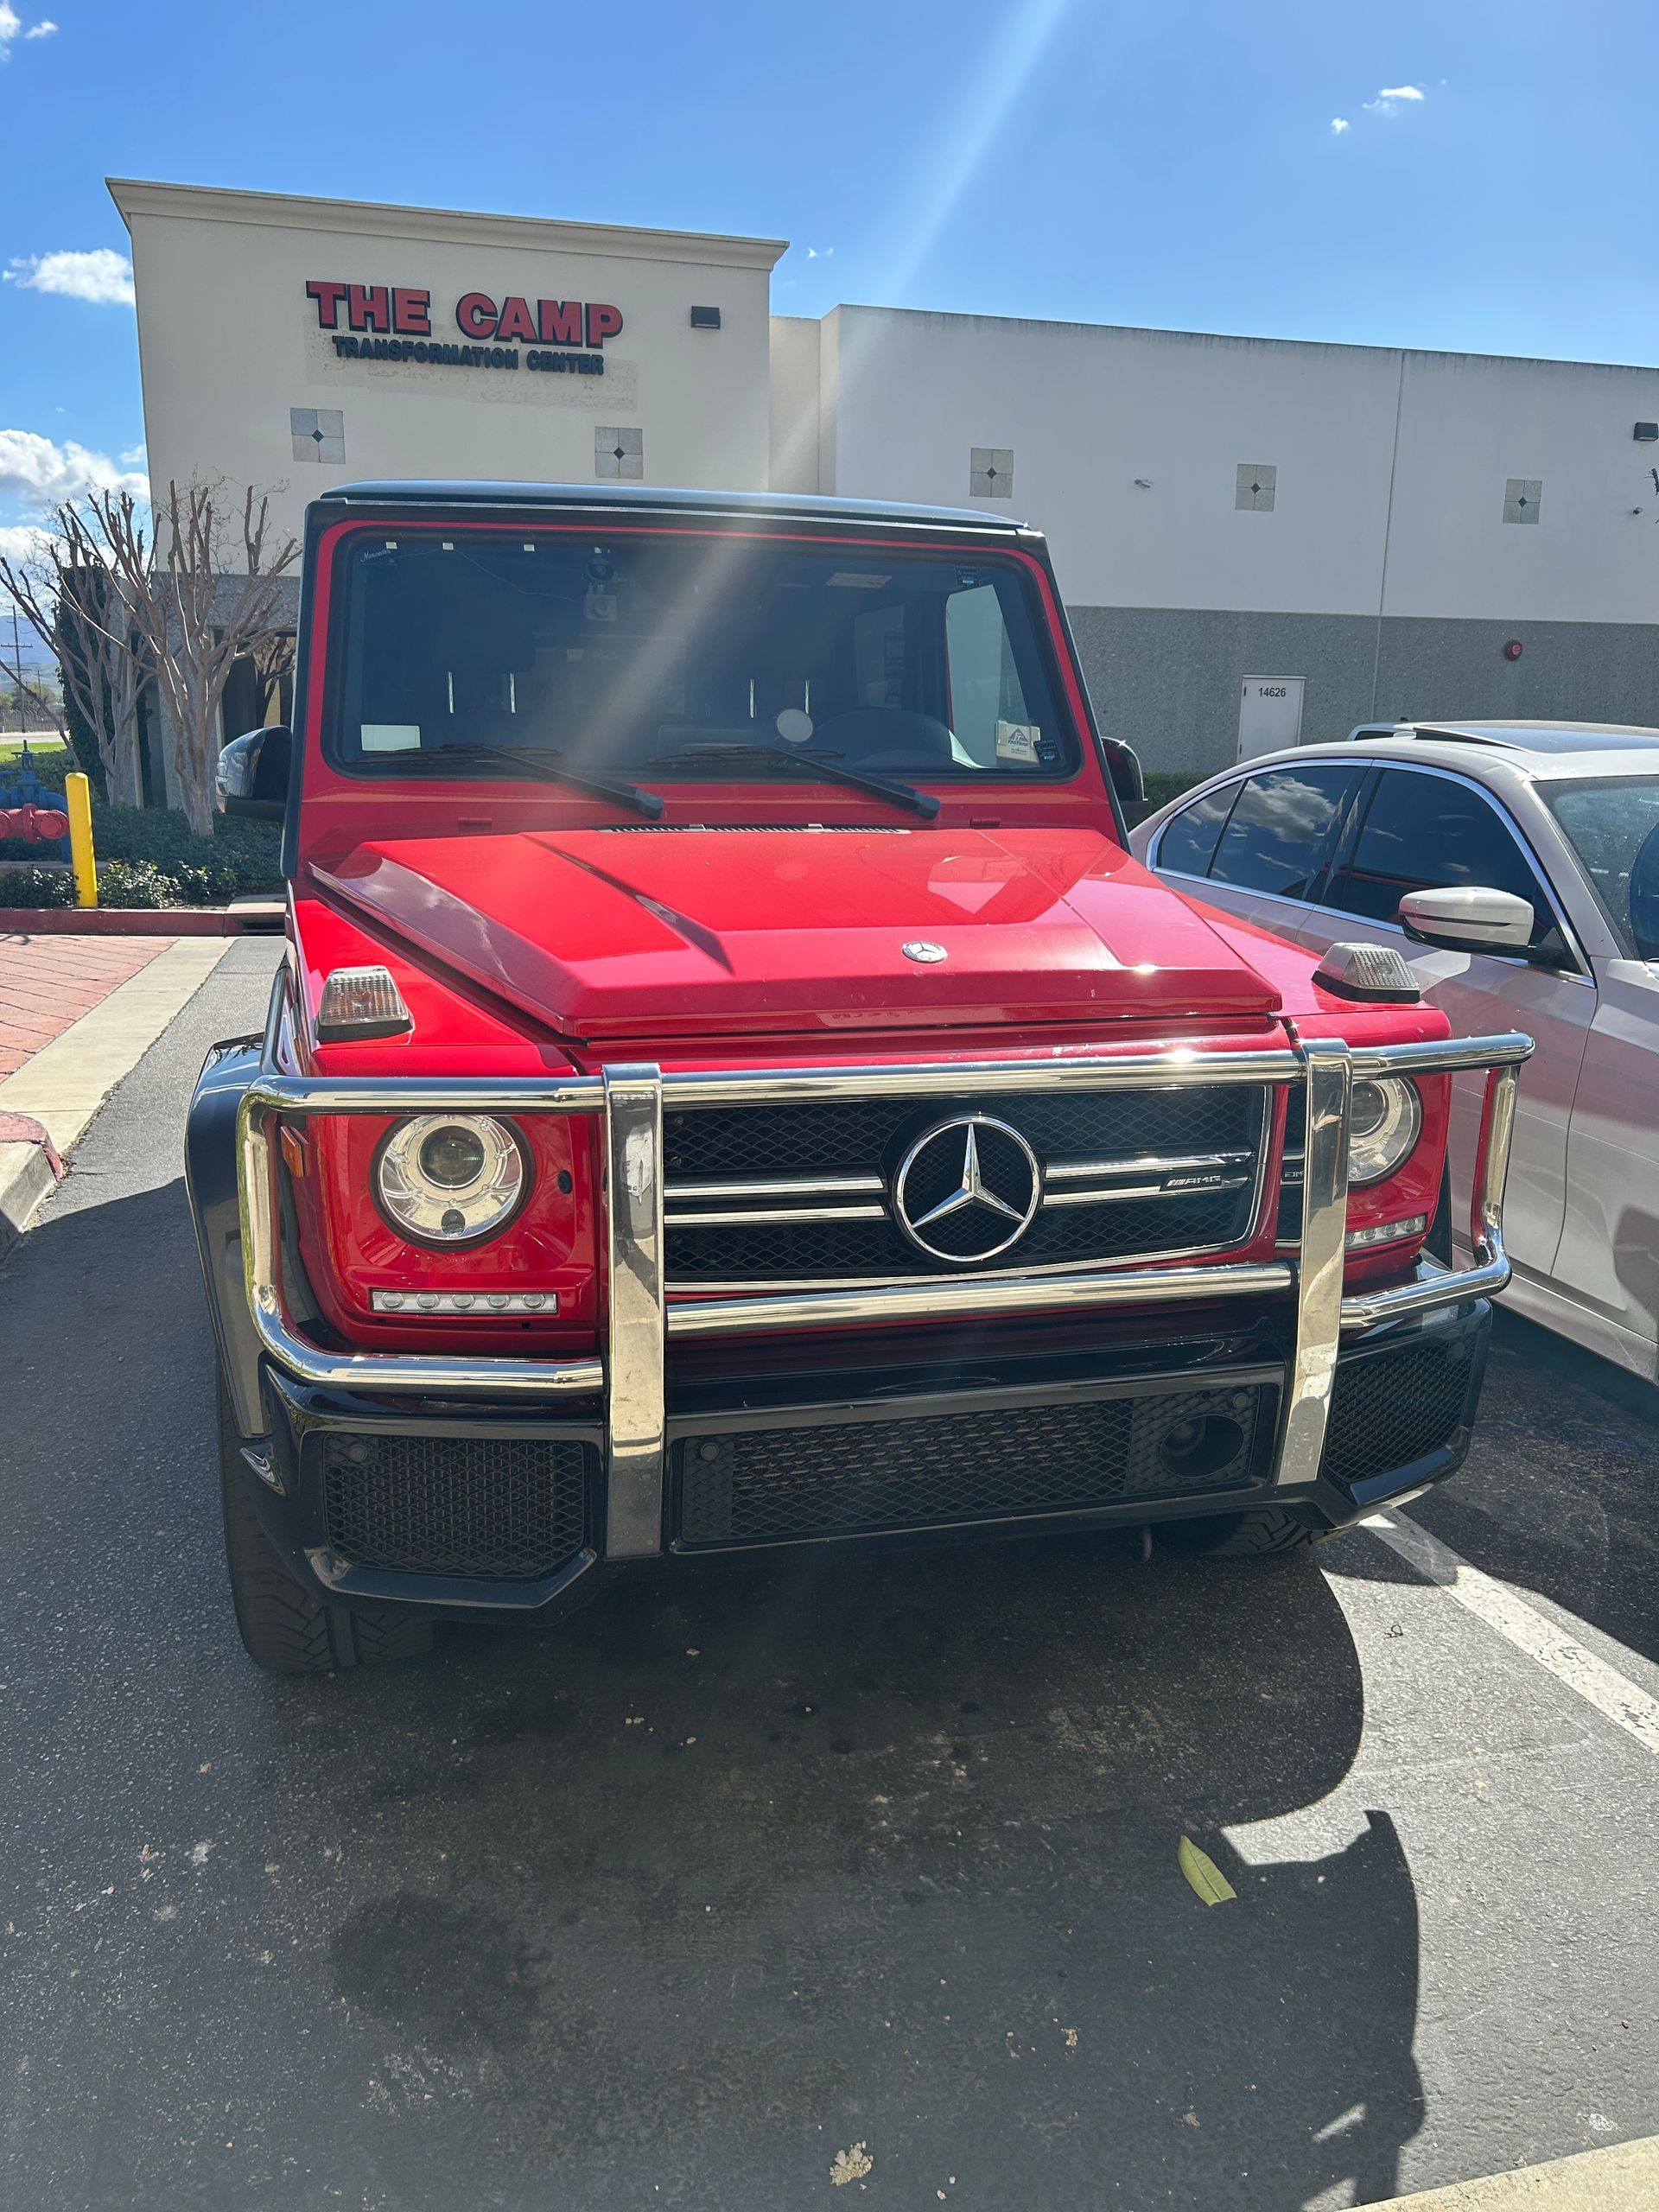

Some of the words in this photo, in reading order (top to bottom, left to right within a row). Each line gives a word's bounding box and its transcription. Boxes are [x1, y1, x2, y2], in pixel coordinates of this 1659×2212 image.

[305, 280, 432, 337] THE
[455, 292, 624, 349] CAMP
[332, 335, 518, 370] TRANSFORMATION
[526, 350, 604, 376] CENTER
[1257, 687, 1287, 697] 14626
[1182, 1174, 1222, 1186] AMG
